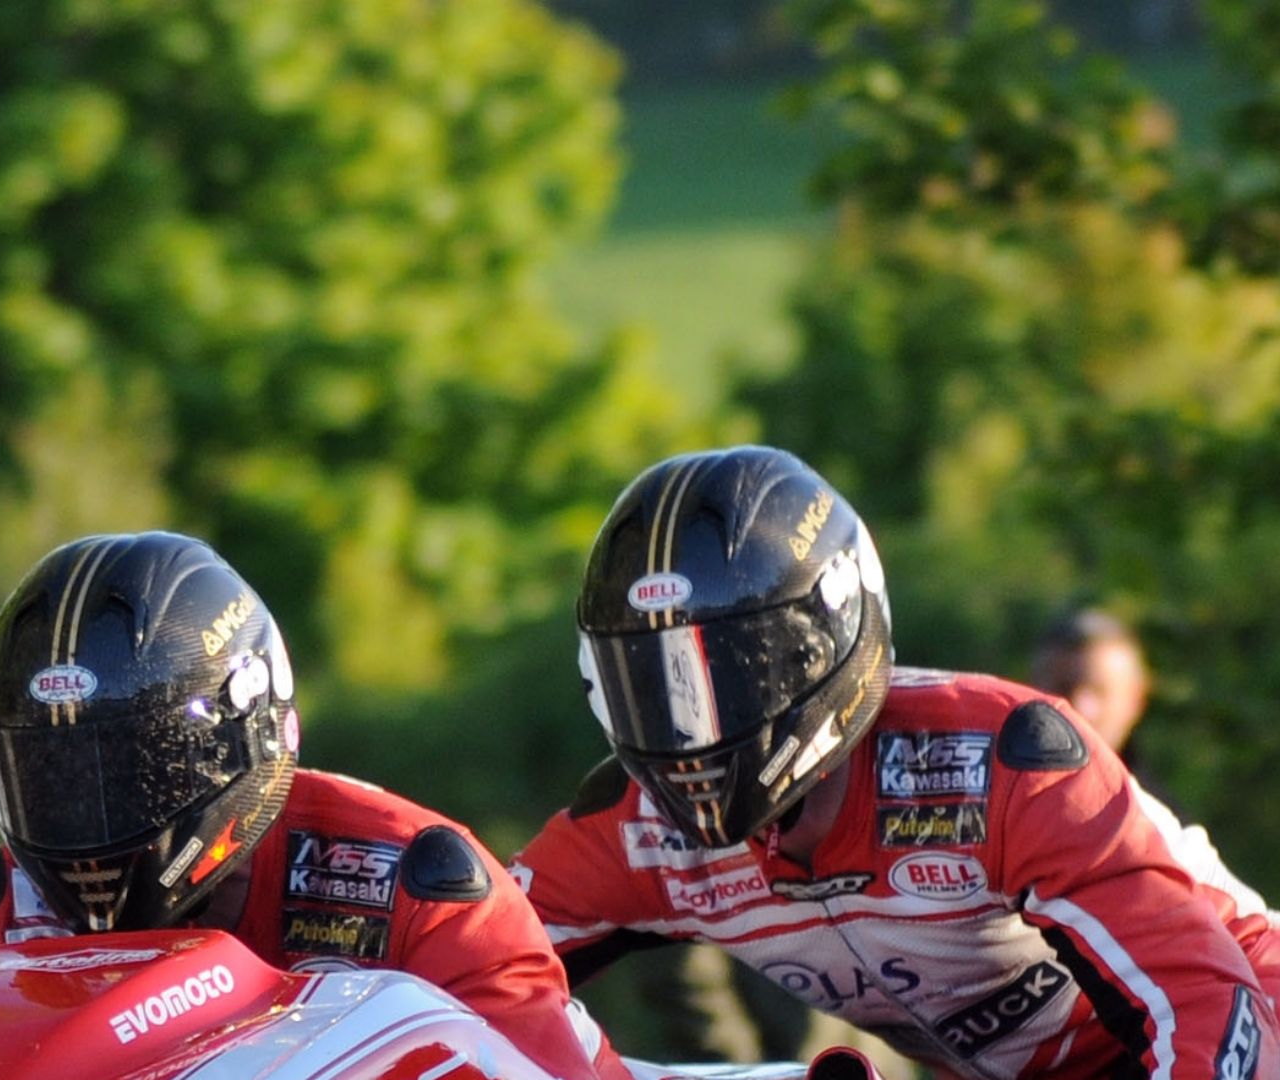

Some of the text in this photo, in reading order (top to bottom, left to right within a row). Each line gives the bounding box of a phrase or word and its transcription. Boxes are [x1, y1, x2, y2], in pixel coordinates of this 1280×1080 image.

[637, 583, 681, 600] BELL
[39, 676, 86, 692] BELL
[881, 764, 986, 791] Kawasaki
[288, 868, 392, 903] Kawasaki
[907, 862, 978, 886] BELL
[109, 964, 234, 1045] EVOMOTO
